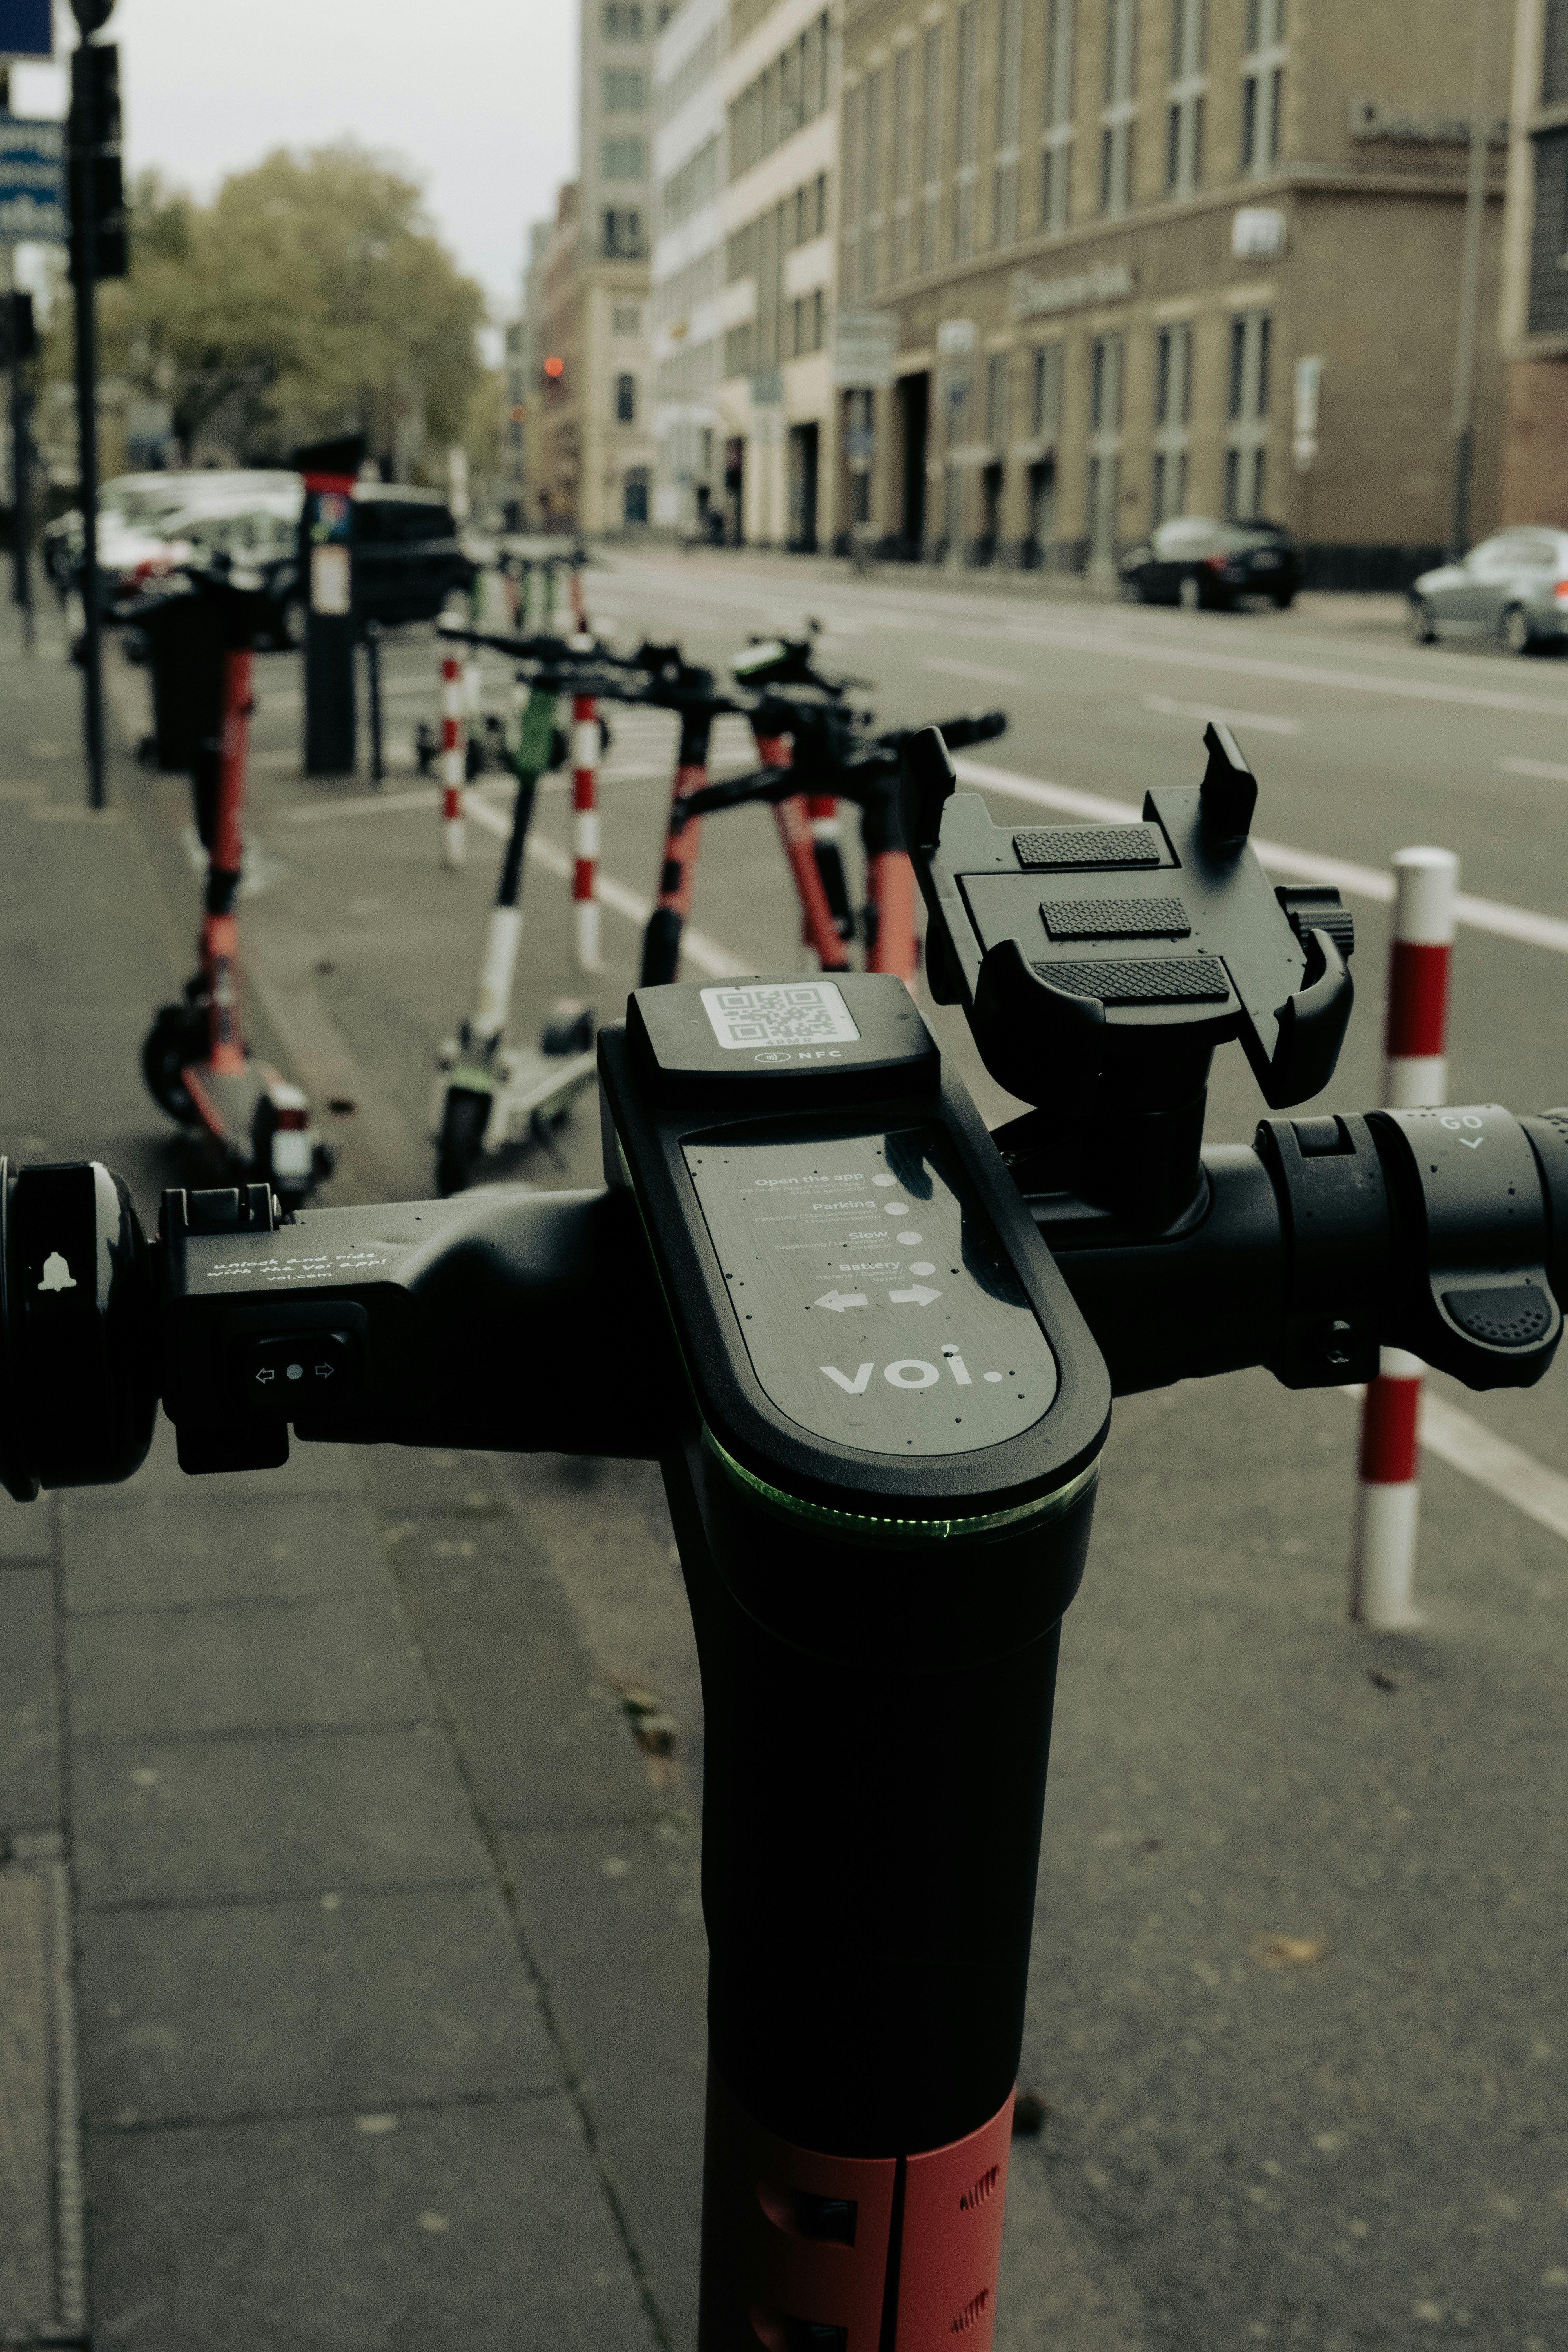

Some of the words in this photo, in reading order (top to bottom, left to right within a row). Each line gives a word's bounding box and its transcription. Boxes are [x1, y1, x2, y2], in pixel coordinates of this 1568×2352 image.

[799, 1050, 842, 1059] NFC
[1440, 1115, 1483, 1130] GO
[755, 1178, 799, 1186] Open
[812, 1201, 875, 1210] Parking
[804, 1209, 873, 1218] Stationnement
[804, 1214, 880, 1224] Estacionamiento
[848, 1231, 887, 1240] Slow
[207, 1268, 252, 1277] with
[340, 1258, 386, 1267] app!
[214, 1259, 278, 1269] unlock
[839, 1261, 900, 1271] Battery
[818, 1343, 1003, 1394] voi.
